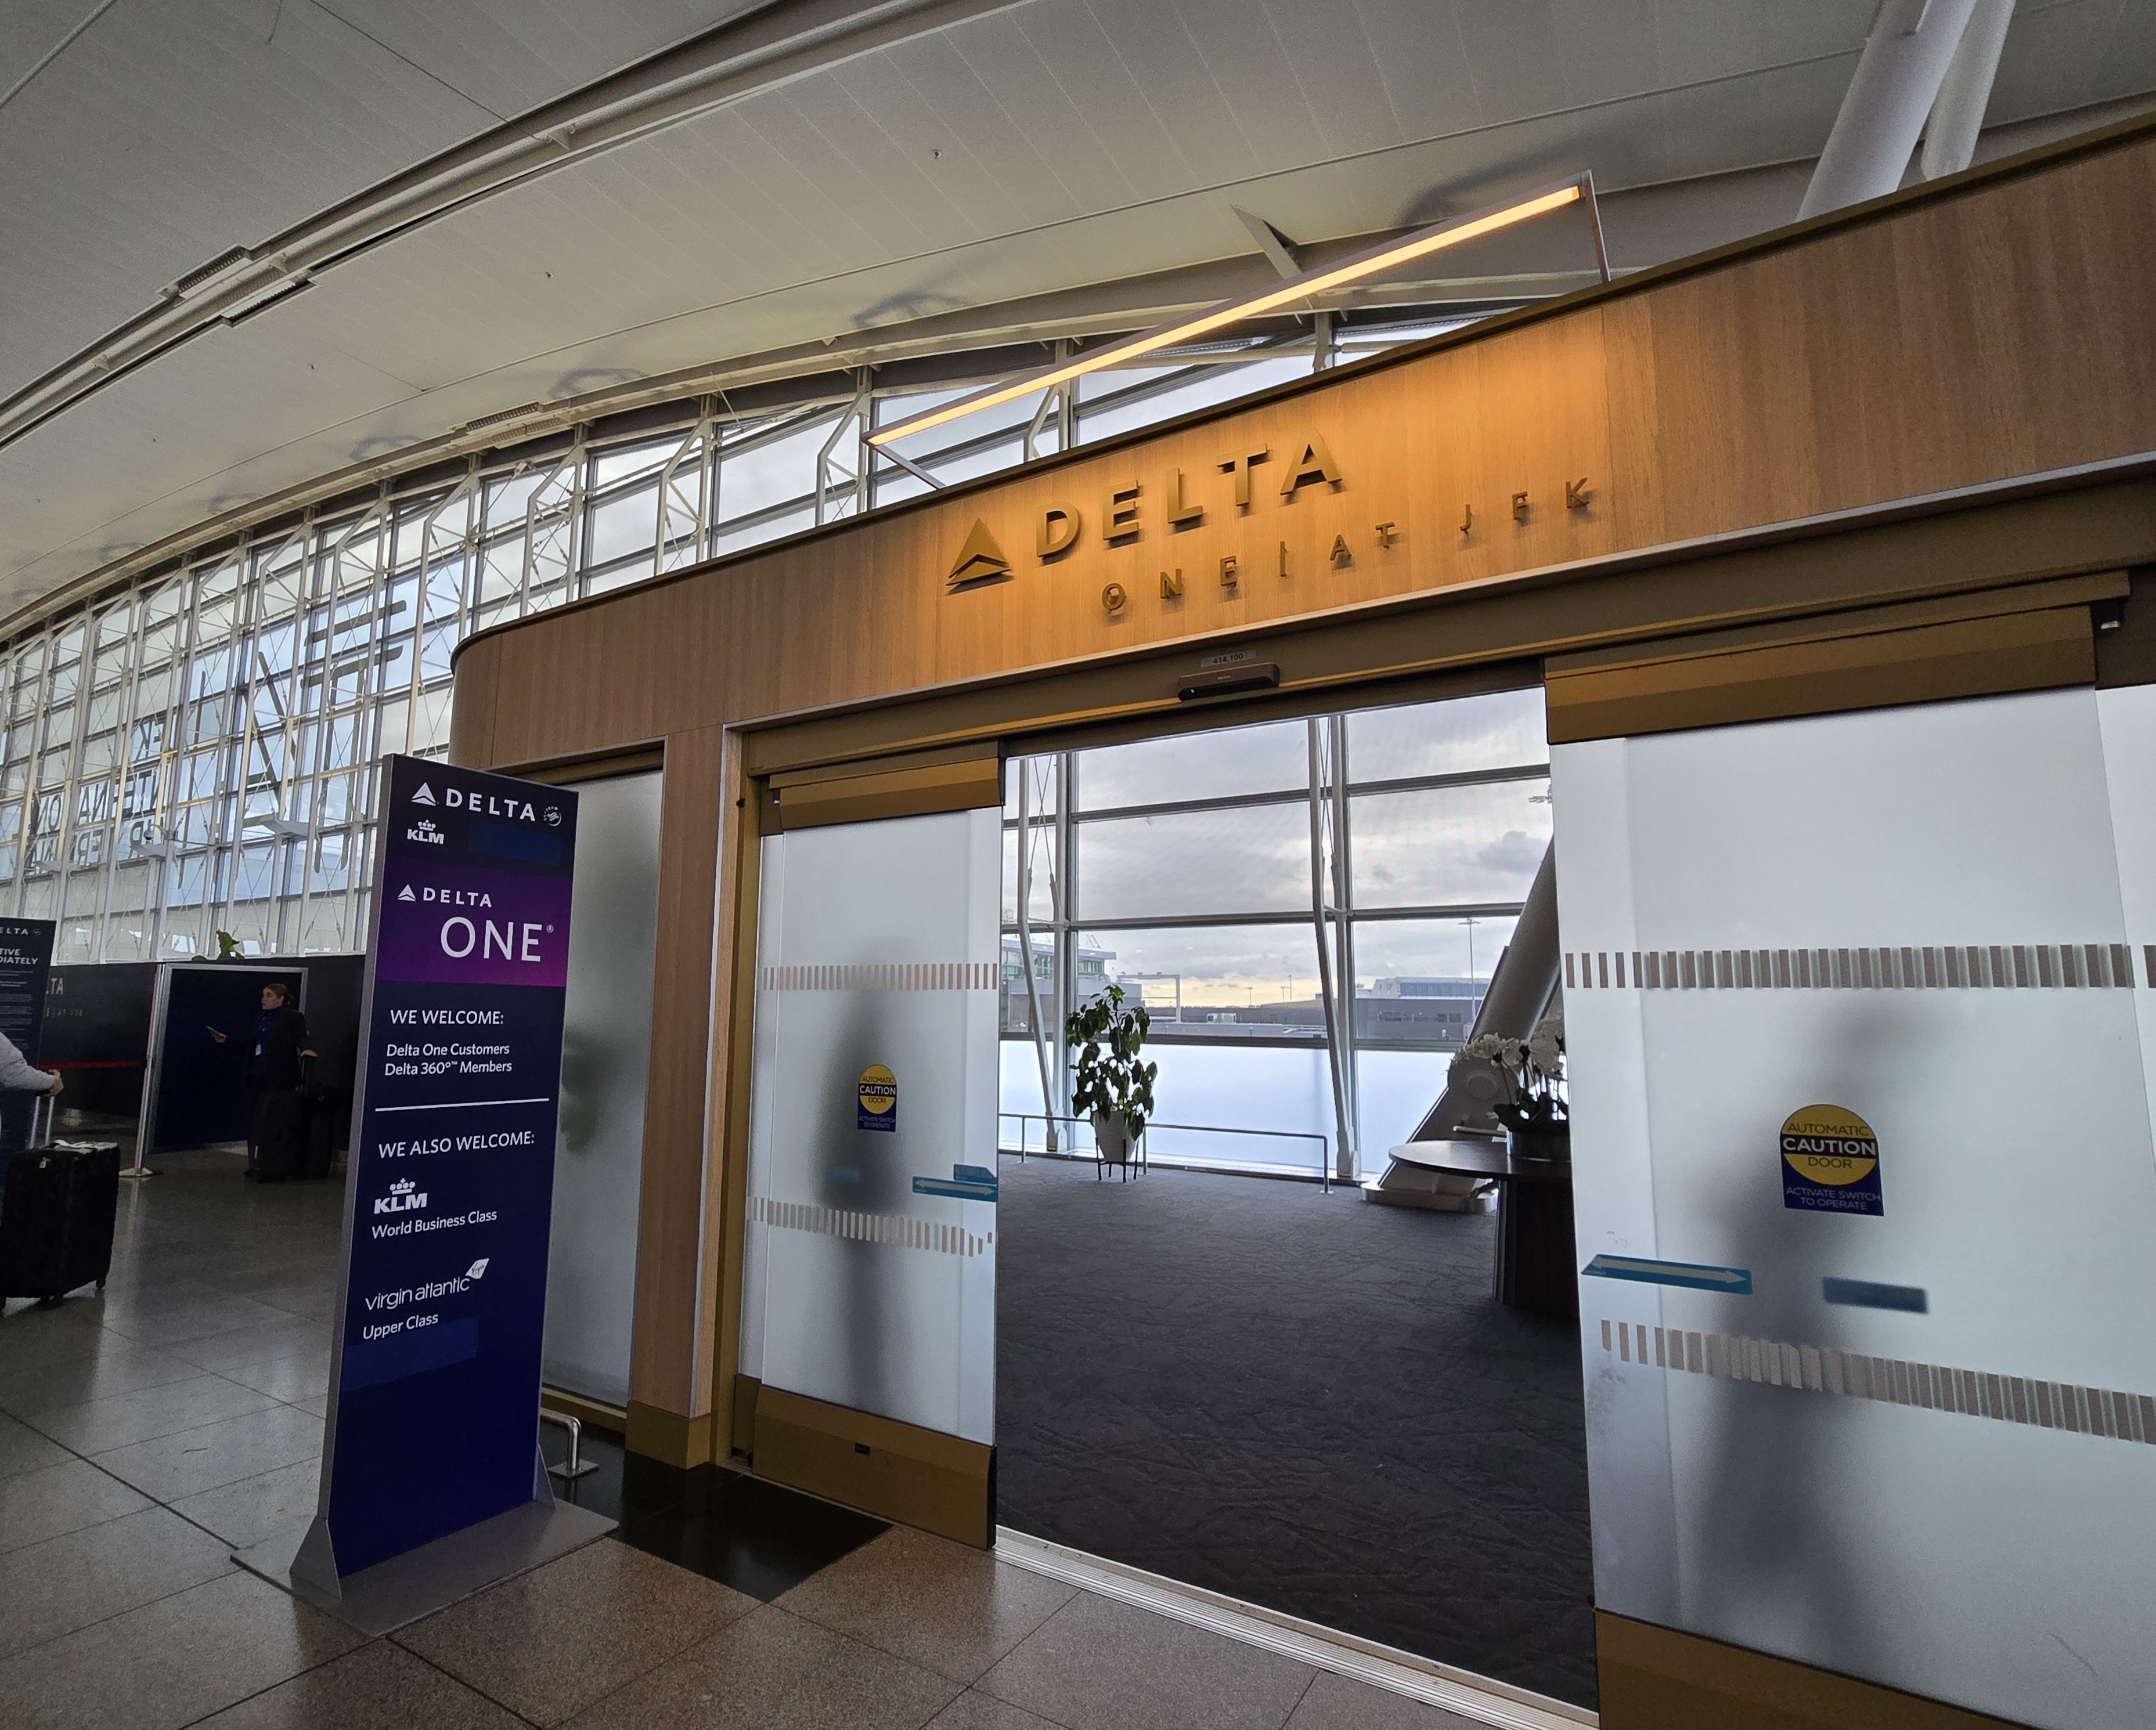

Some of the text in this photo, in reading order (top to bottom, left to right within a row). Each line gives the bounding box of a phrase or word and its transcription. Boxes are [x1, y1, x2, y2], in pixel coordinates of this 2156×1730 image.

[1036, 428, 1343, 558] DELTA
[1102, 555, 1238, 613] ONE
[1329, 522, 1396, 561] AT
[1459, 477, 1589, 534] JFK
[1213, 653, 1243, 663] 414.100
[445, 788, 536, 821] DELTA
[407, 829, 445, 844] KLM
[423, 887, 492, 908] DELTA
[0, 927, 28, 935] ELTA
[0, 948, 21, 956] TIVE
[0, 956, 39, 965] DIATELY
[390, 1009, 504, 1025] WE WELCOME:
[387, 1043, 510, 1057] Delta One Customers
[384, 1063, 419, 1076] Delta
[459, 1061, 512, 1074] Members
[861, 1075, 895, 1084] AUTOMATIC
[859, 1085, 896, 1096] CAUTION
[1787, 1123, 1869, 1136] AUTOMATIC
[378, 1131, 535, 1158] WE ALSO WELCOME:
[1783, 1137, 1876, 1155] CAUTION
[1808, 1157, 1853, 1169] DOOR
[1786, 1187, 1881, 1202] ACTIVATE SWITCH
[374, 1193, 428, 1214] KLM
[1800, 1197, 1867, 1211] TO OPERATE
[372, 1210, 497, 1239] World Business Class
[365, 1276, 470, 1310] virgin atlantic
[363, 1313, 439, 1341] Upper Class
